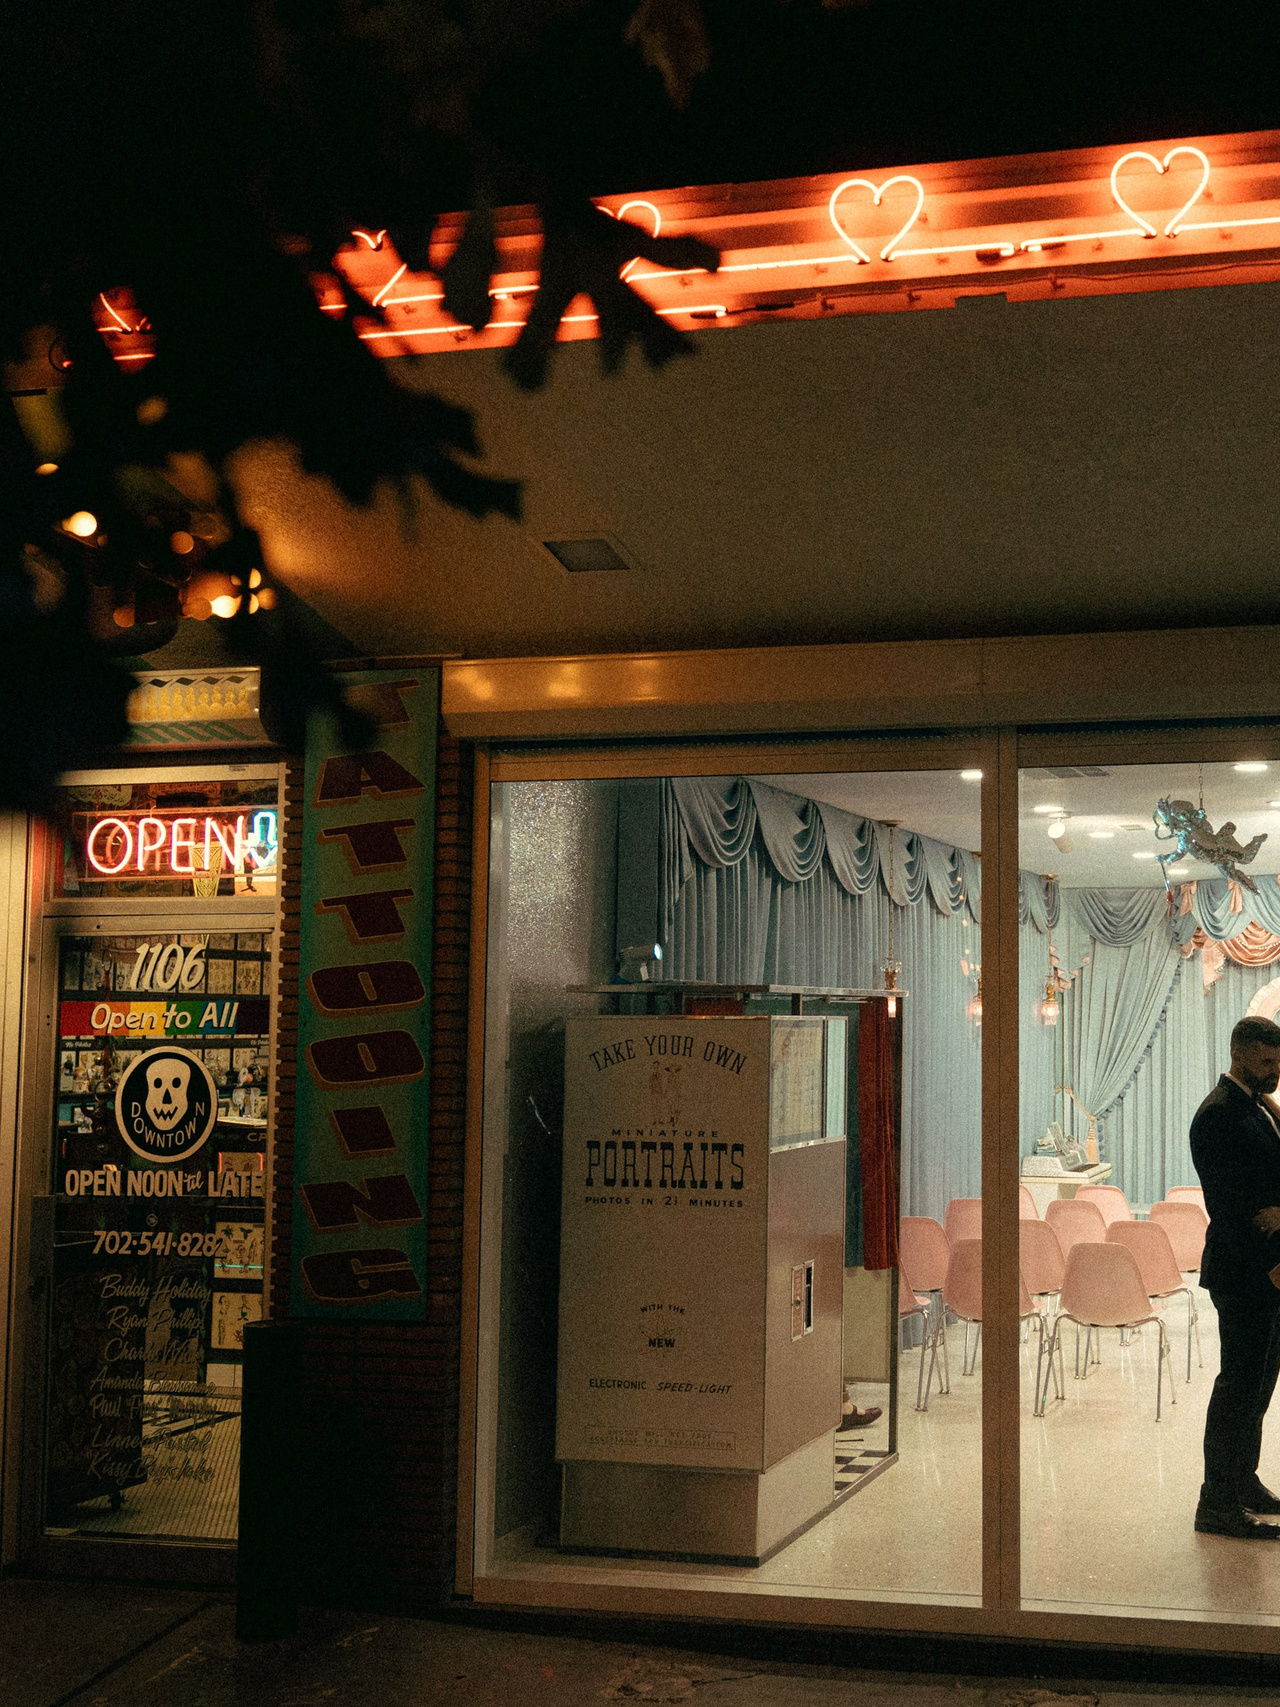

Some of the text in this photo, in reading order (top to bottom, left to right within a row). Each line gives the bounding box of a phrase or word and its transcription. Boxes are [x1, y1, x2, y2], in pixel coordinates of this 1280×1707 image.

[86, 815, 244, 875] OPEN
[129, 942, 206, 991] 1106
[300, 676, 428, 1307] TATTOOING
[90, 1001, 238, 1033] Open to All
[589, 1034, 749, 1076] TAKE YOUR OWN
[130, 1101, 206, 1149] DOWNTOWN
[611, 1128, 720, 1139] MINIATURE
[585, 1139, 745, 1191] PORTRAITS
[64, 1168, 122, 1198] OPEN
[126, 1169, 184, 1198] NOON
[208, 1169, 265, 1198] LATE
[584, 1195, 632, 1205] PHOTOS
[641, 1197, 654, 1206] IN
[688, 1198, 744, 1209] MINUTES
[98, 1272, 212, 1309] Buddy Holiday
[105, 1304, 148, 1338] Ryan
[639, 1303, 686, 1316] WITH THE
[647, 1337, 677, 1349] NEW
[588, 1377, 647, 1391] ELECTRONIC
[88, 1392, 123, 1420] Paul
